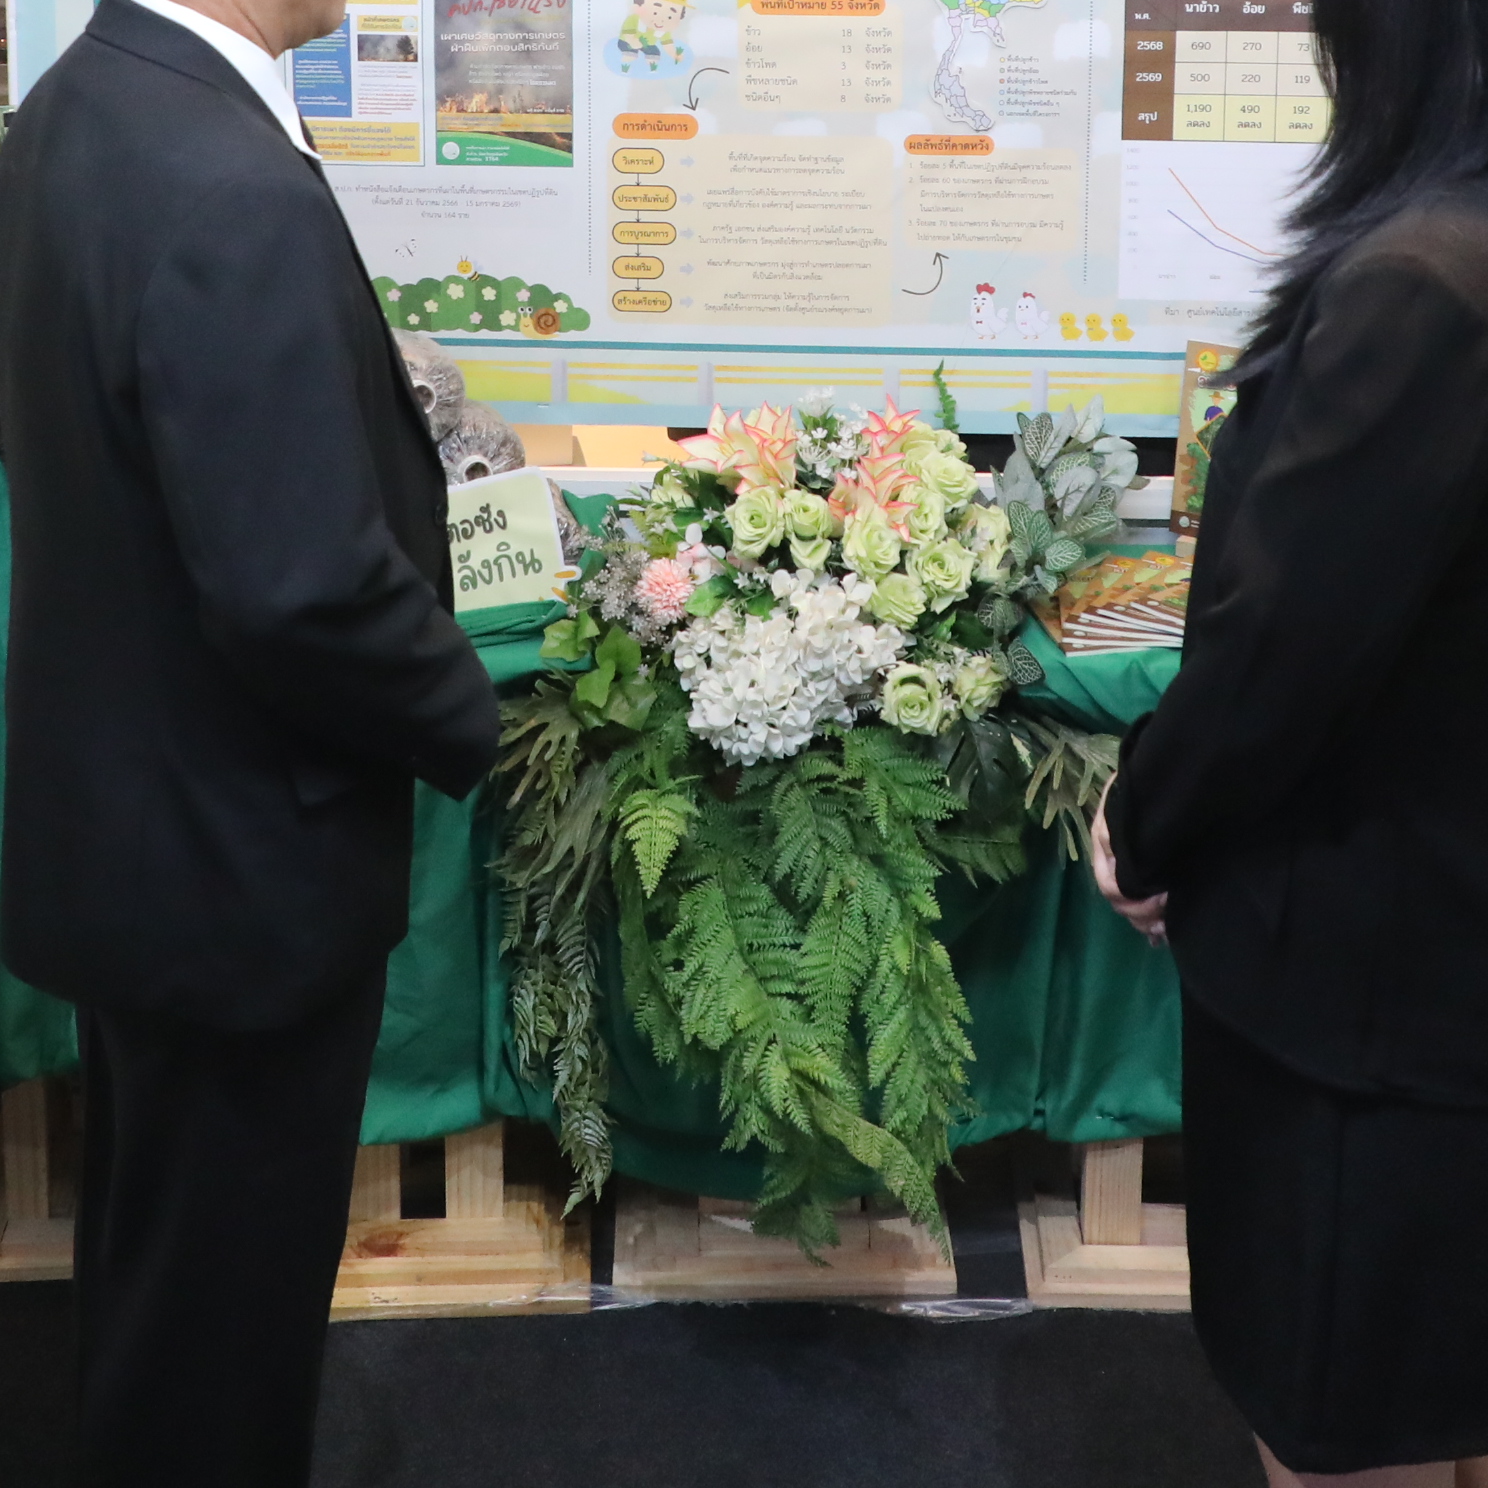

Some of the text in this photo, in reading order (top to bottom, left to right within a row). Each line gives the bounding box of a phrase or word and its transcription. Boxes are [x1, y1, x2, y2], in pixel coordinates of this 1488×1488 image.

[831, 1, 844, 9] 55
[848, 0, 880, 10] จังหวัด
[1185, 2, 1266, 15] นาข้าว อ้อย
[1135, 12, 1151, 20] พ.ศ.
[745, 25, 892, 37] ข้าว 18 จังหวัด
[746, 42, 762, 52] อ้อย
[865, 44, 892, 54] จังหวัด
[1137, 40, 1262, 52] 2568 690 270
[746, 58, 892, 70] ข้าวโพด 3 จังหวัด
[864, 77, 891, 87] จังหวัด
[1136, 72, 1310, 84] 2569 500 220 119
[864, 94, 891, 104] จังหวัด
[1186, 104, 1310, 115] 1,190 490 192
[1138, 110, 1313, 130] สรุป ลดลง ลดลง ลดลง
[623, 121, 688, 133] การดำเนินการ
[909, 139, 989, 152] ผลลัพธ์ที่คาดหวัง
